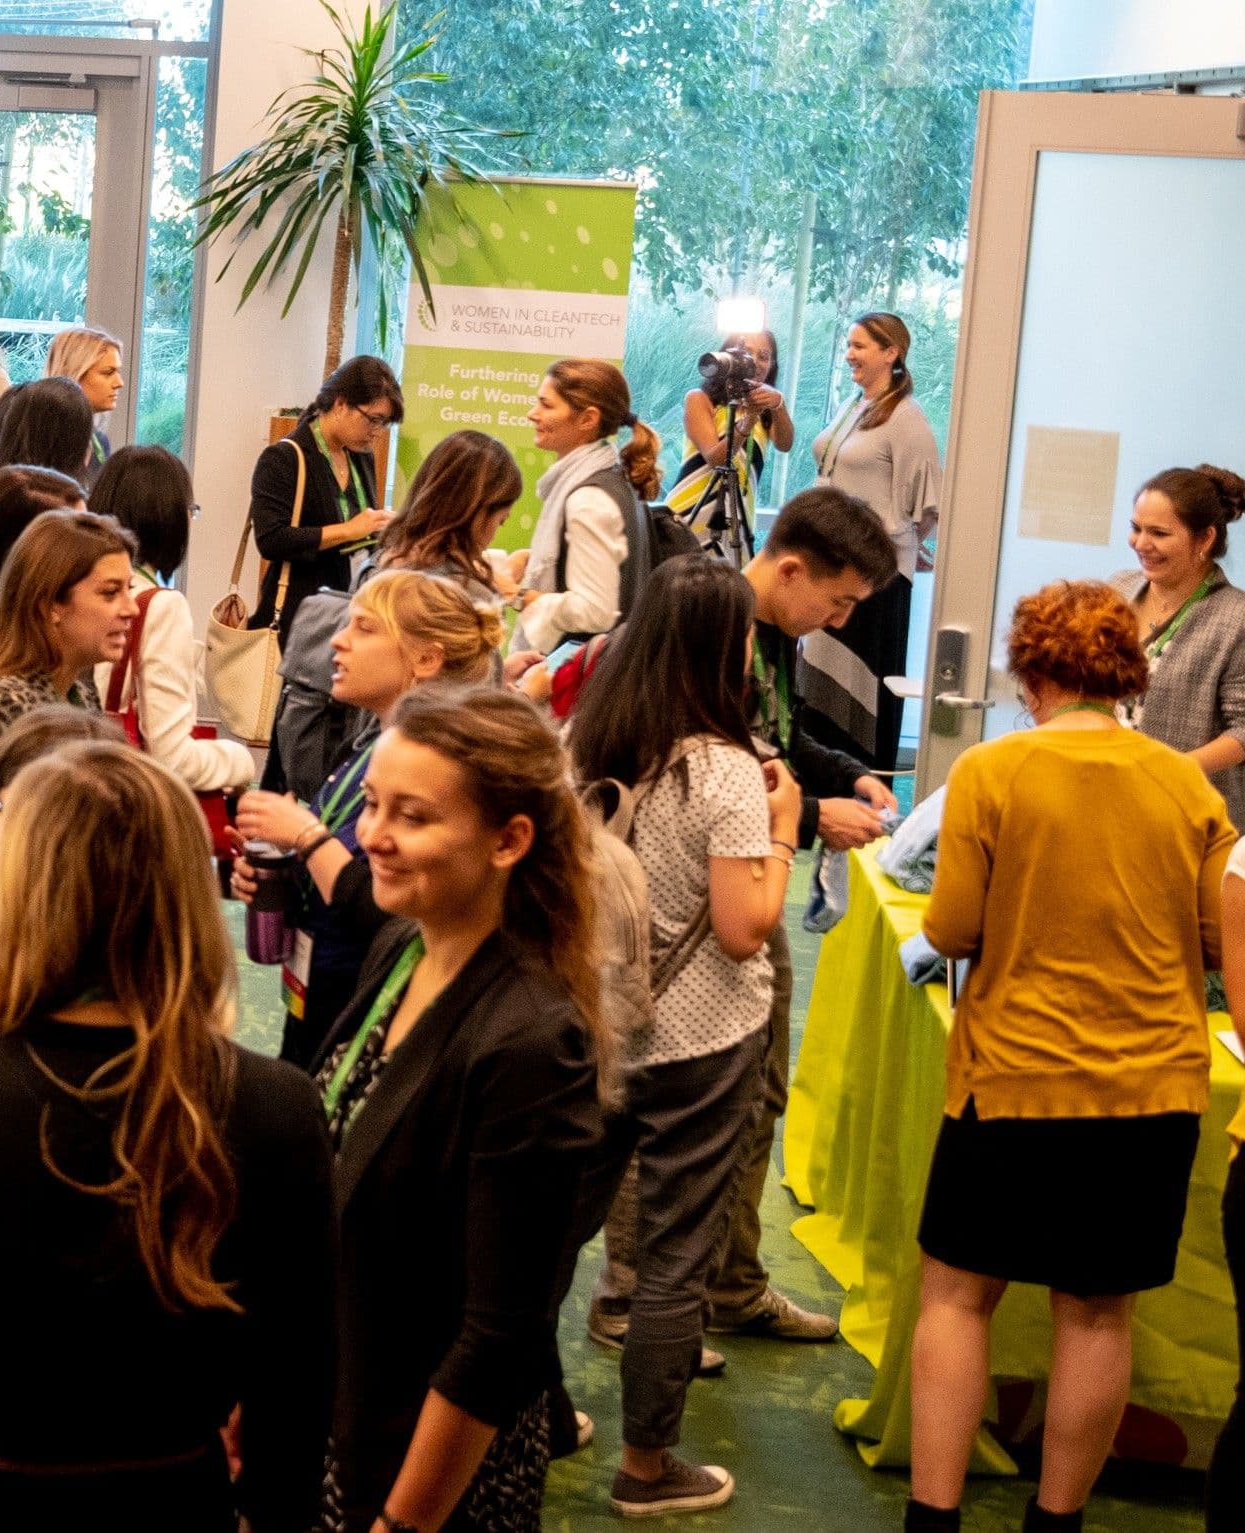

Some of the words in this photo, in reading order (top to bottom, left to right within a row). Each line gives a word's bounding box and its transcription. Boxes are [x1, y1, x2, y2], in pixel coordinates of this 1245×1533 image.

[451, 304, 509, 319] WOMEN
[514, 308, 529, 321] IN
[533, 309, 620, 326] CLEANTECH
[450, 319, 460, 332] &
[464, 320, 575, 339] SUSTAINABILITY
[450, 363, 540, 388] Furthering
[417, 383, 454, 400] Role
[460, 385, 480, 401] of
[483, 387, 537, 406] Wome
[439, 405, 491, 424] Green
[498, 410, 533, 426] Eco
